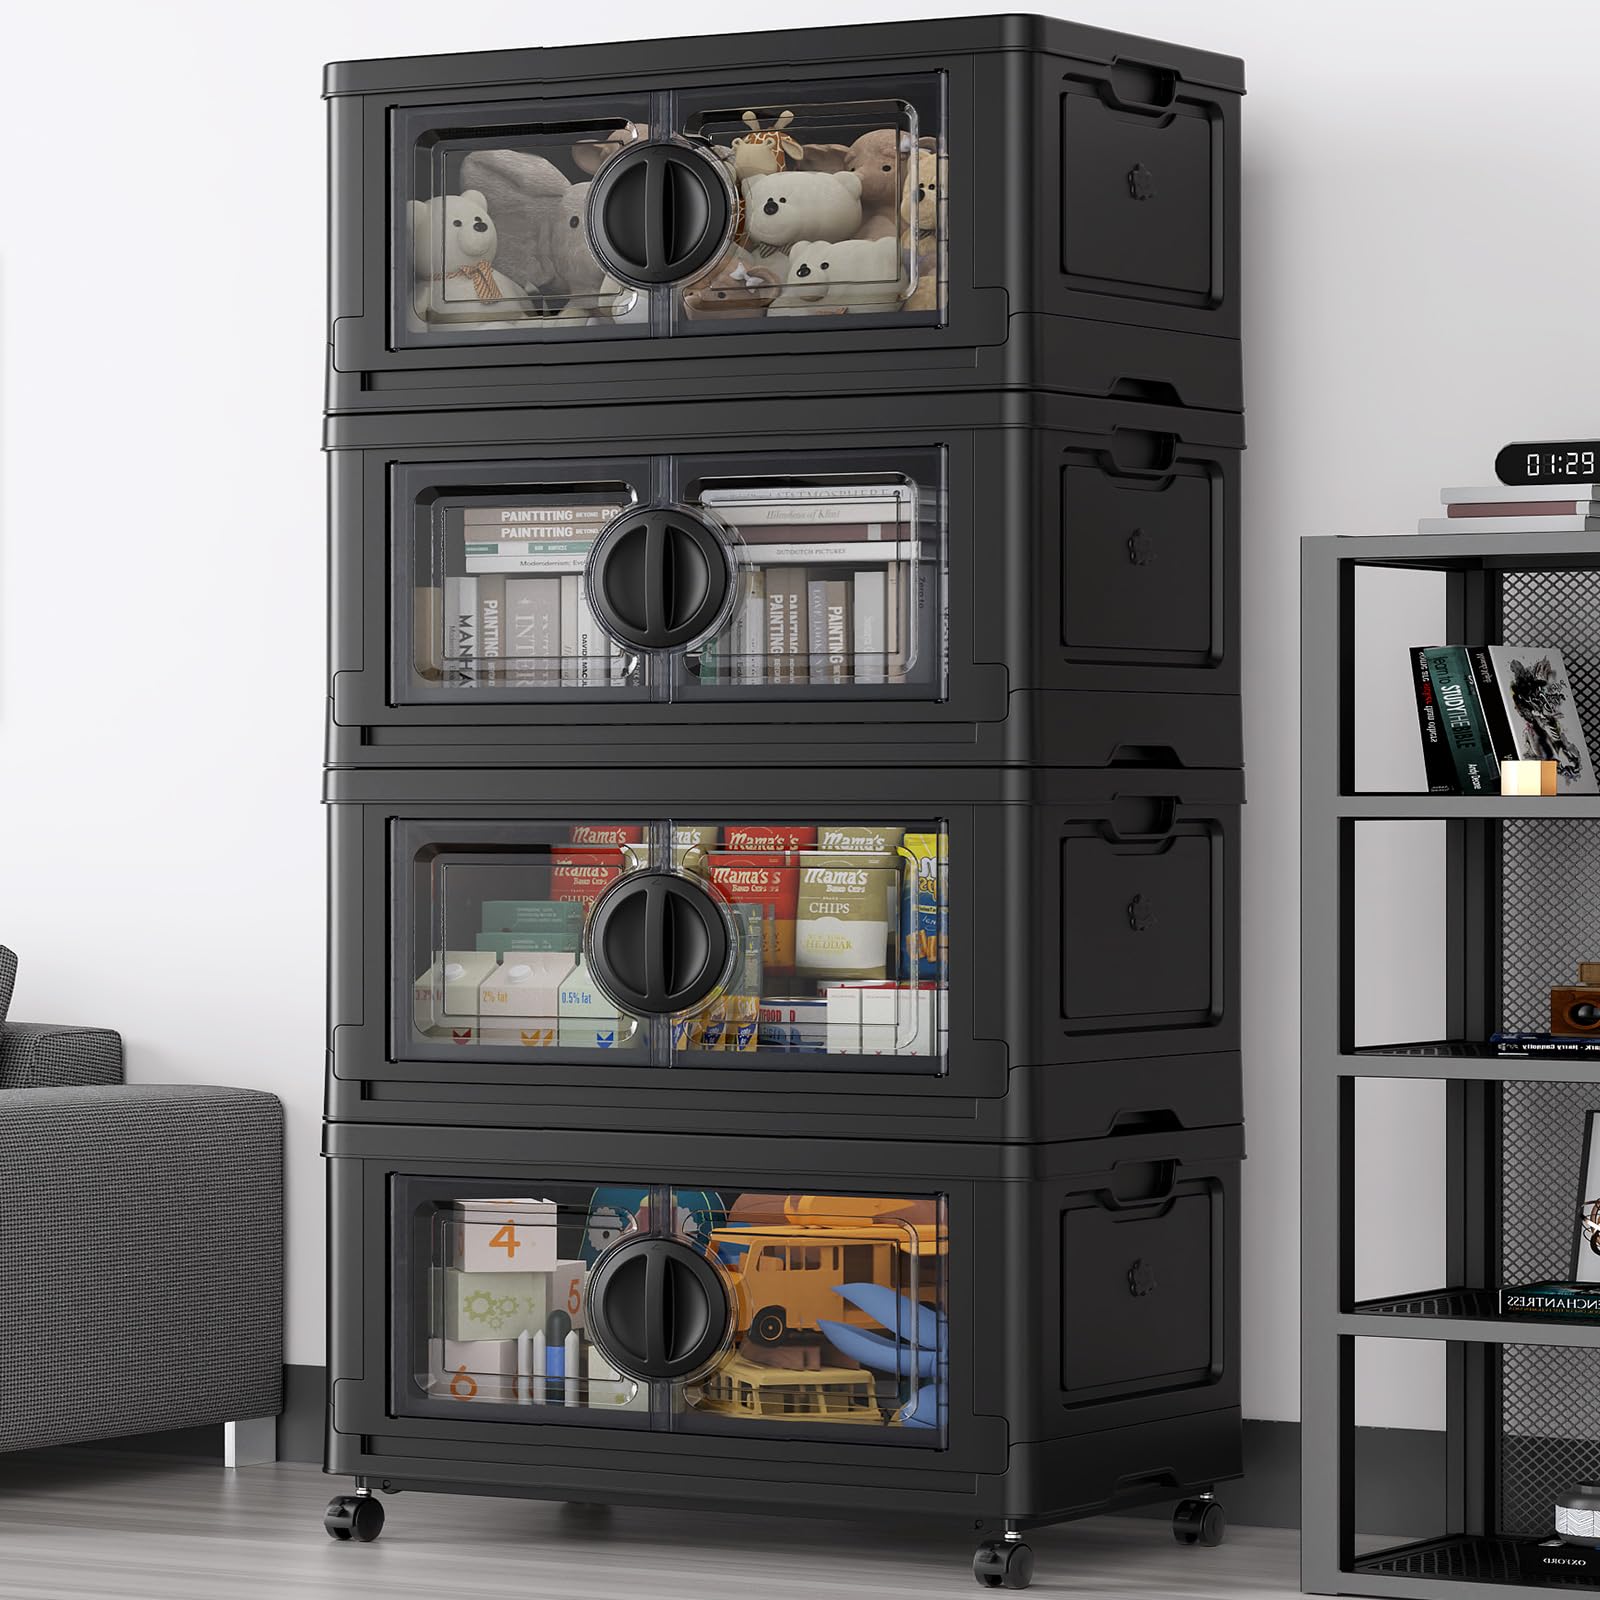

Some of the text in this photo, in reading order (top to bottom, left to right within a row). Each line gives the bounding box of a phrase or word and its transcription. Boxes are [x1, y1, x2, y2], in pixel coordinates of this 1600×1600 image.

[1527, 451, 1594, 476] 01:29
[484, 600, 498, 659] PAINTING
[769, 594, 784, 654] PAINTING
[828, 606, 844, 663] PAINTING
[459, 615, 474, 687] MANHA
[572, 827, 627, 845] Mama's
[728, 832, 785, 850] Mama's
[821, 831, 886, 851] Mama's
[713, 867, 769, 885] Mama's
[804, 868, 869, 886] Mama's
[809, 902, 850, 914] CHIPS
[561, 991, 592, 1004] 0.5% fat
[488, 1218, 521, 1259] 4
[568, 1278, 581, 1314] 5
[449, 1364, 478, 1402] 6
